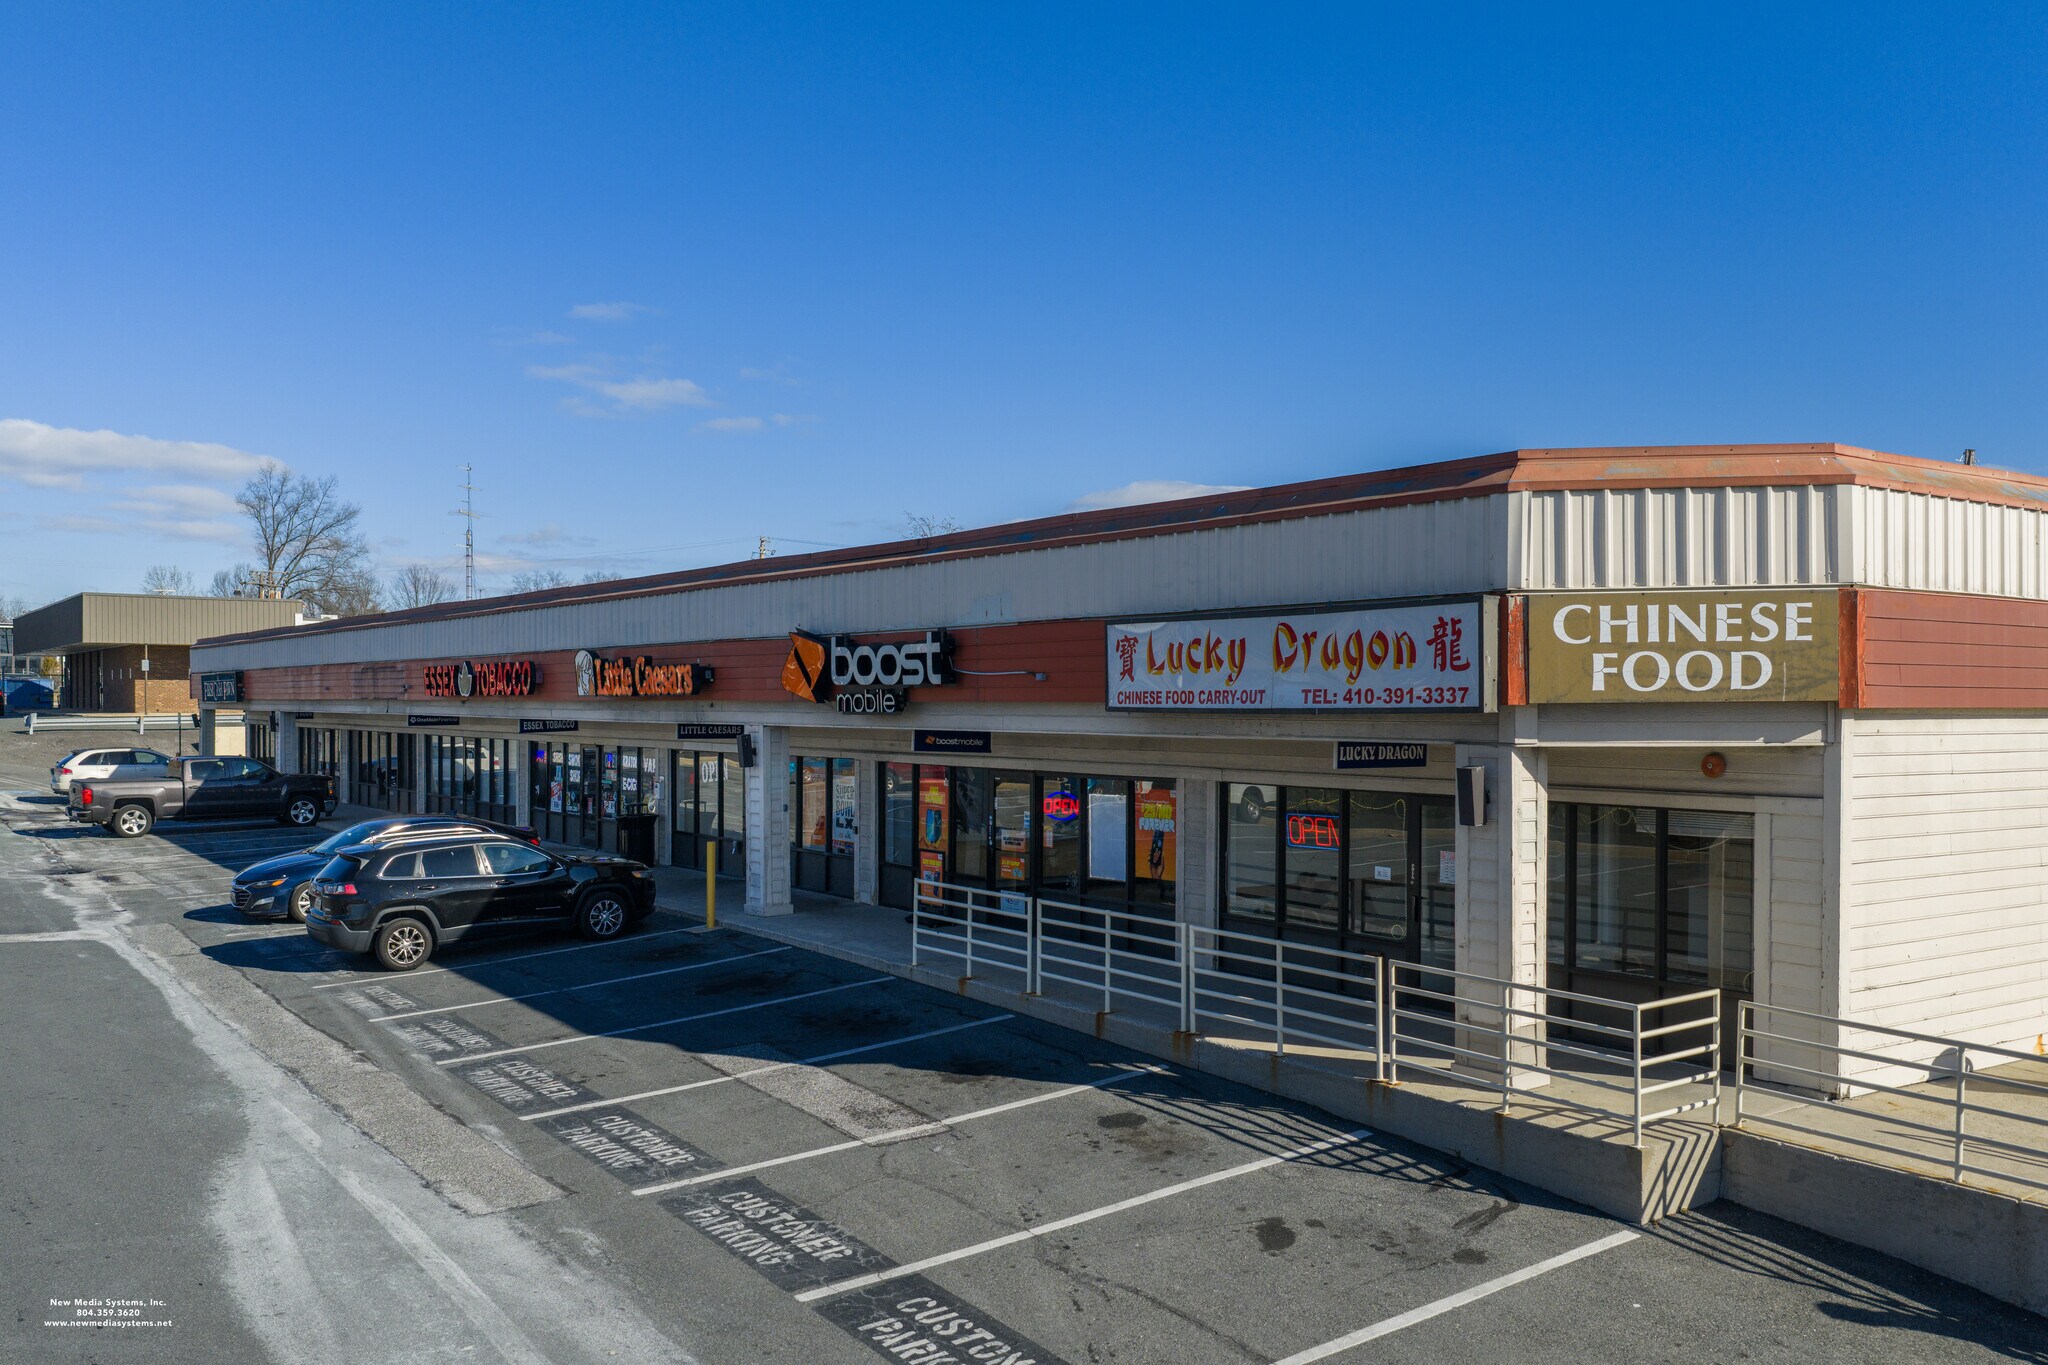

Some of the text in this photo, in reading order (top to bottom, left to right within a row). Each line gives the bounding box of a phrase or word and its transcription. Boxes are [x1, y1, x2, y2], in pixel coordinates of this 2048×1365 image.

[1552, 601, 1813, 645] CHINESE
[830, 631, 942, 685] boost
[1146, 622, 1417, 687] Lucky Dragon
[1426, 616, 1471, 672] 龍
[423, 660, 531, 697] ESSEX TOBACCO
[594, 655, 693, 697] Little Caesars
[1591, 650, 1774, 692] FOOD
[836, 689, 896, 713] mobile
[1117, 689, 1266, 705] CHINESE FOOD CARRY-OUT
[1301, 686, 1470, 705] TEL: 410-391-3337
[523, 720, 575, 731] ESSEX TOBACCO
[680, 725, 742, 735] LITTLE CAESARS
[1339, 744, 1425, 761] LUCKY DRAGON
[1043, 797, 1080, 816] OPEN
[1288, 815, 1340, 847] OPEN
[591, 1115, 696, 1167] CUSTOMER
[684, 1206, 794, 1266] PARKING
[718, 1190, 854, 1263] CUSTOMER
